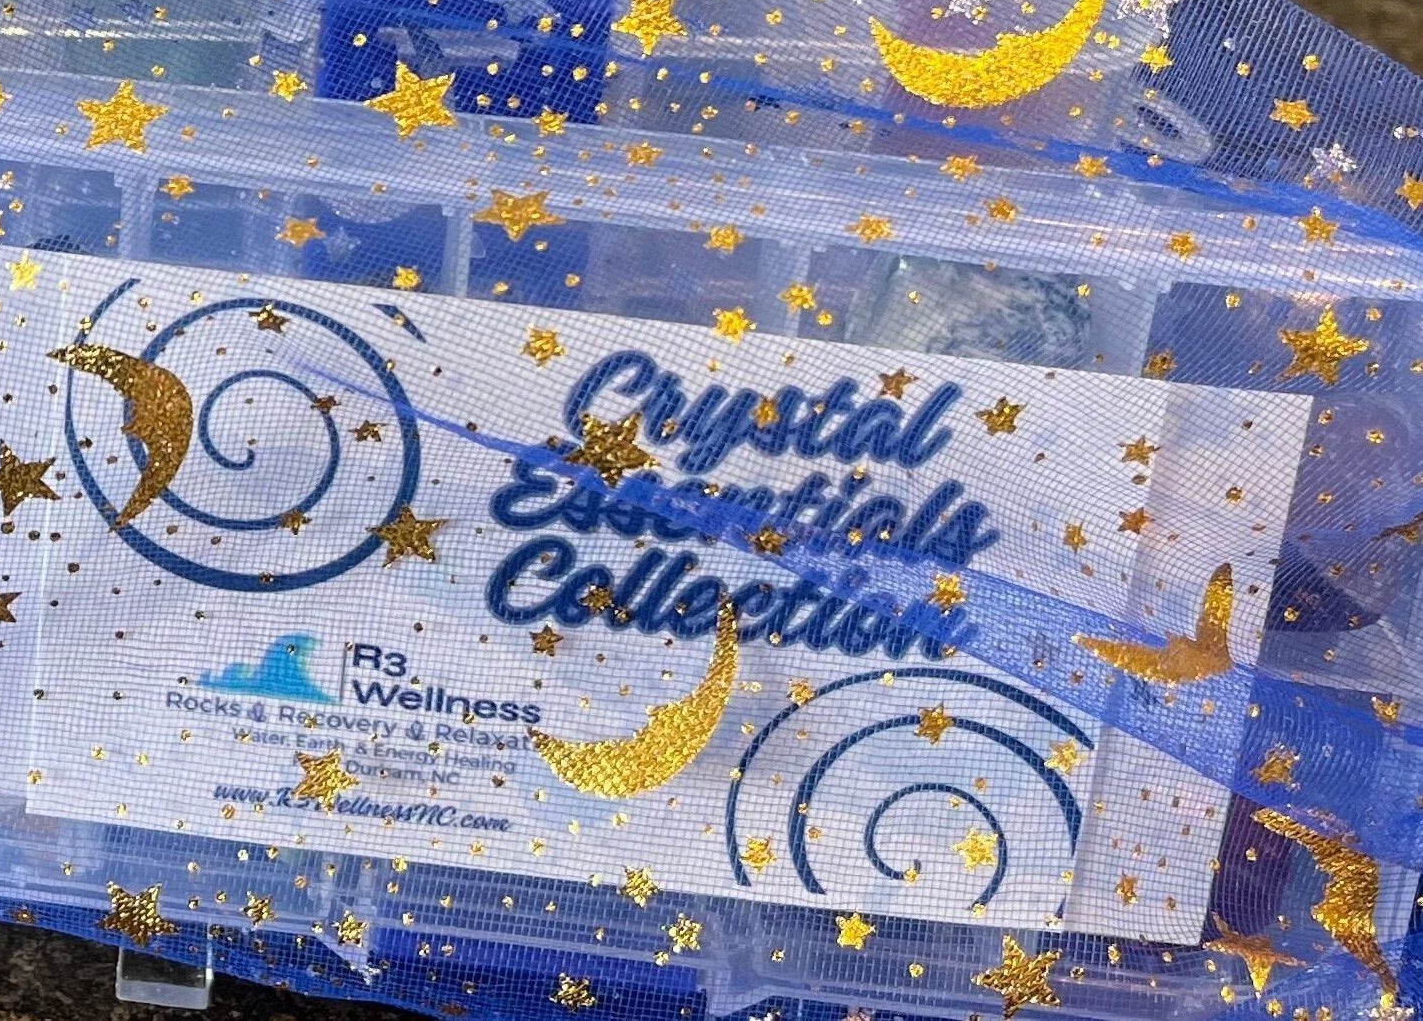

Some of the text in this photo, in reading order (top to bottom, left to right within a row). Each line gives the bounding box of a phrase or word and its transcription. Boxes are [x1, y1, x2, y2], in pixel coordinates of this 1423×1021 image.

[563, 350, 964, 472] Crystal
[352, 643, 407, 678] R3
[166, 691, 243, 718] Rocks
[278, 705, 398, 740] Recovery
[436, 723, 533, 751] Relaxat
[351, 678, 542, 724] Wellness
[374, 744, 437, 767] Energy
[444, 749, 516, 775] Healing
[431, 769, 461, 786] NC
